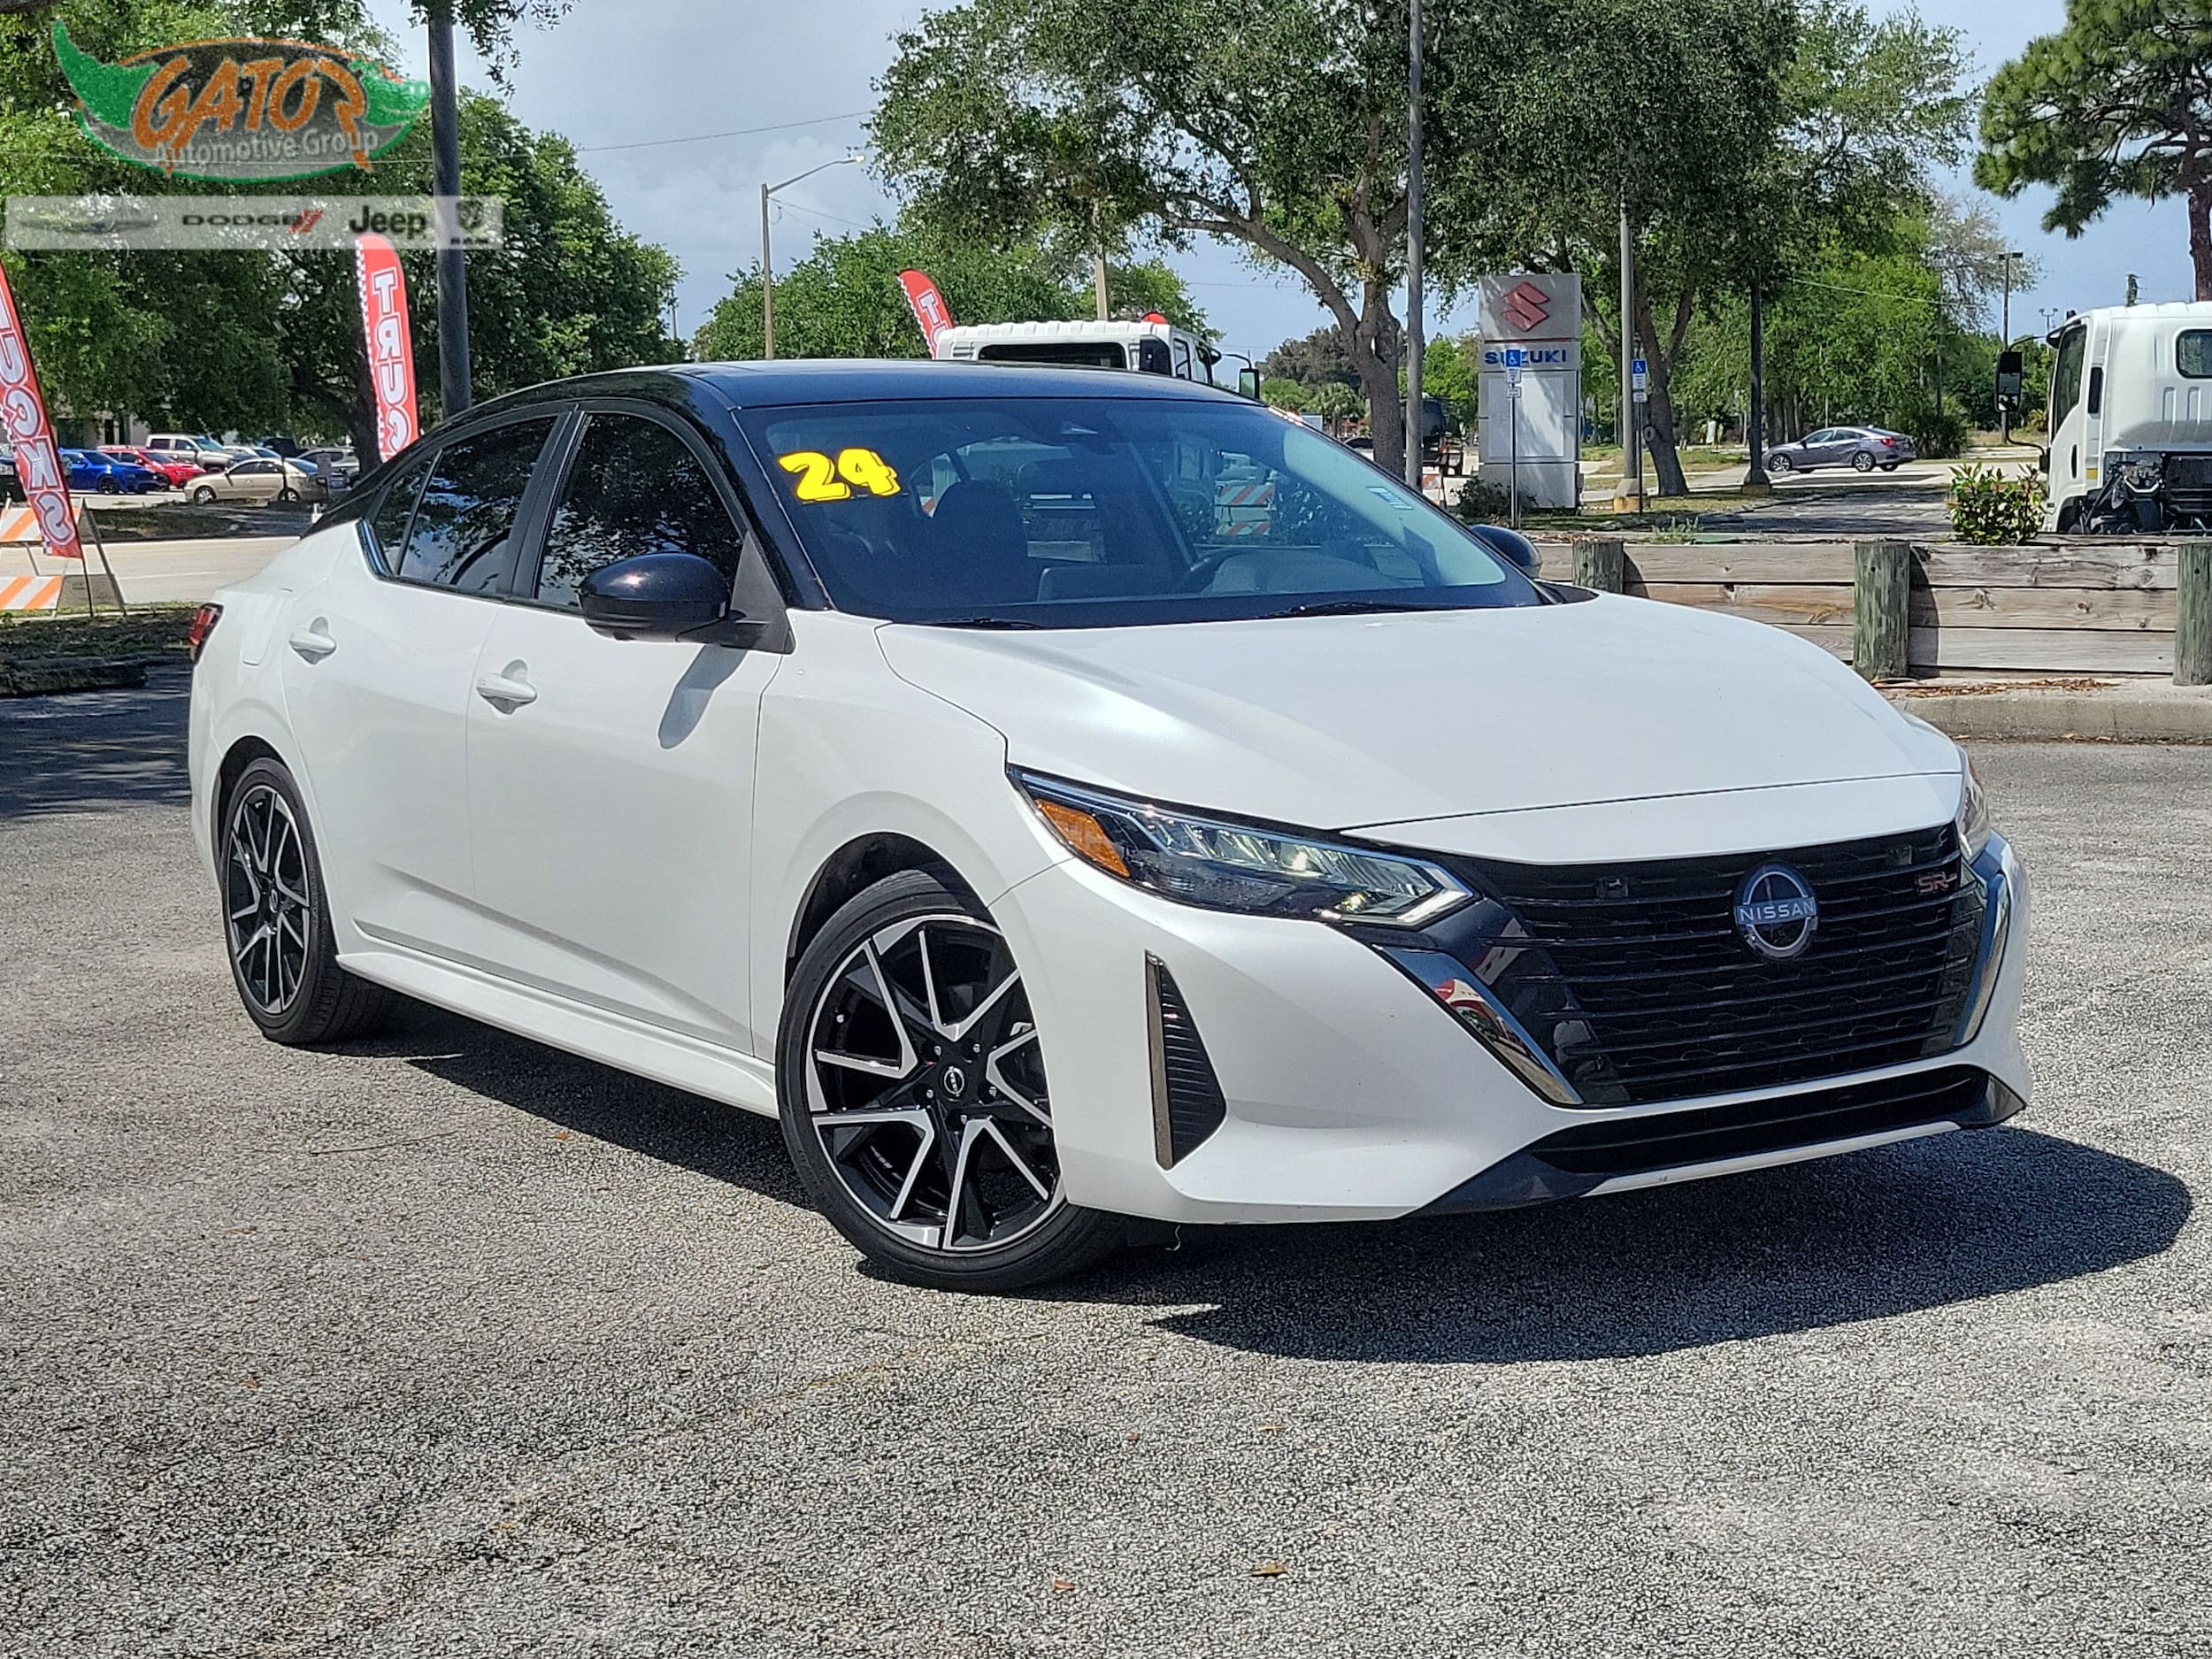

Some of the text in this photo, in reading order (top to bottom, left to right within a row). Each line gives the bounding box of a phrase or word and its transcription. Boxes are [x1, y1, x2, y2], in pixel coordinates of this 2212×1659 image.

[779, 448, 901, 502] 24
[1917, 872, 1948, 893] SR
[1740, 901, 1814, 921] NISSAN
